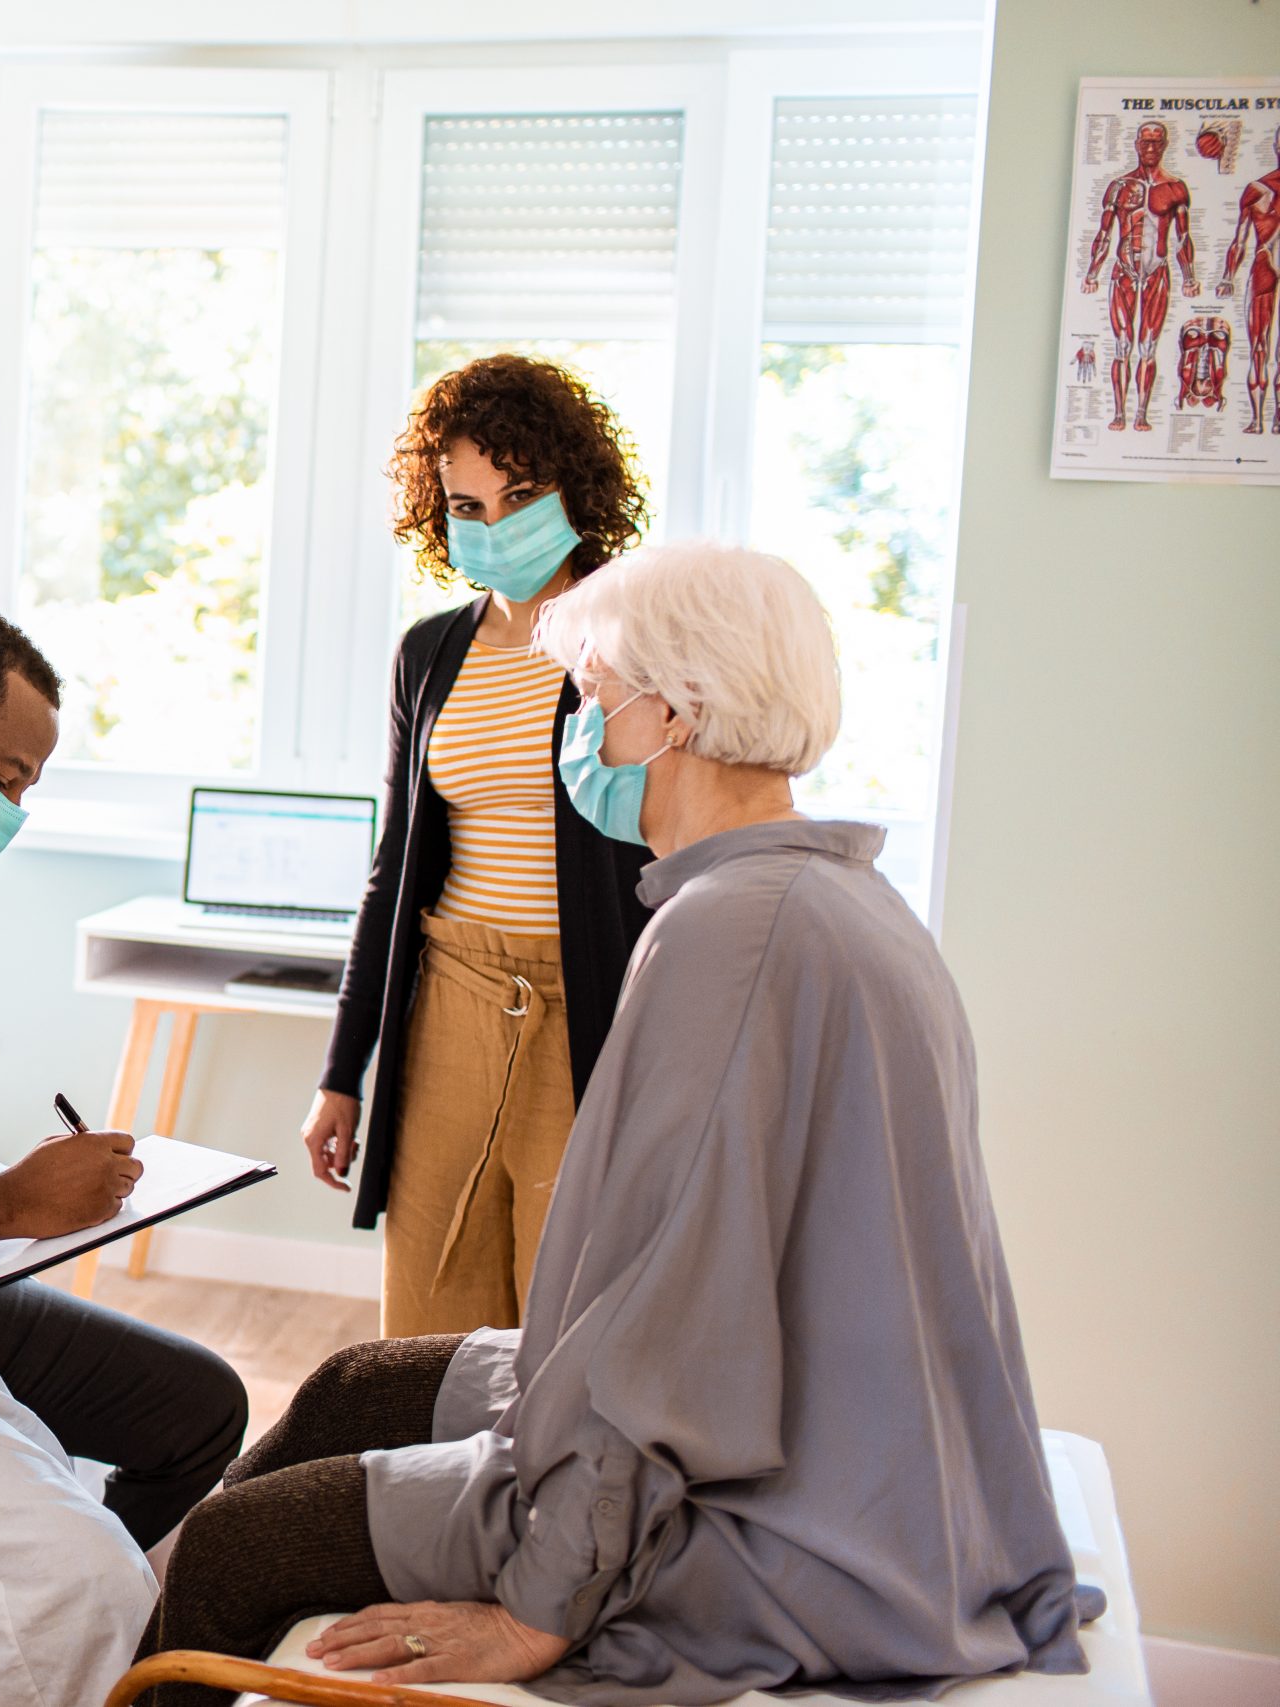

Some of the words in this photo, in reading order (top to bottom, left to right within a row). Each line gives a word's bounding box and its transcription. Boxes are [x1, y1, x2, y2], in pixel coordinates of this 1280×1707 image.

[1122, 98, 1154, 110] THE
[1160, 98, 1249, 110] MUSCULAR
[1255, 98, 1280, 109] SY
